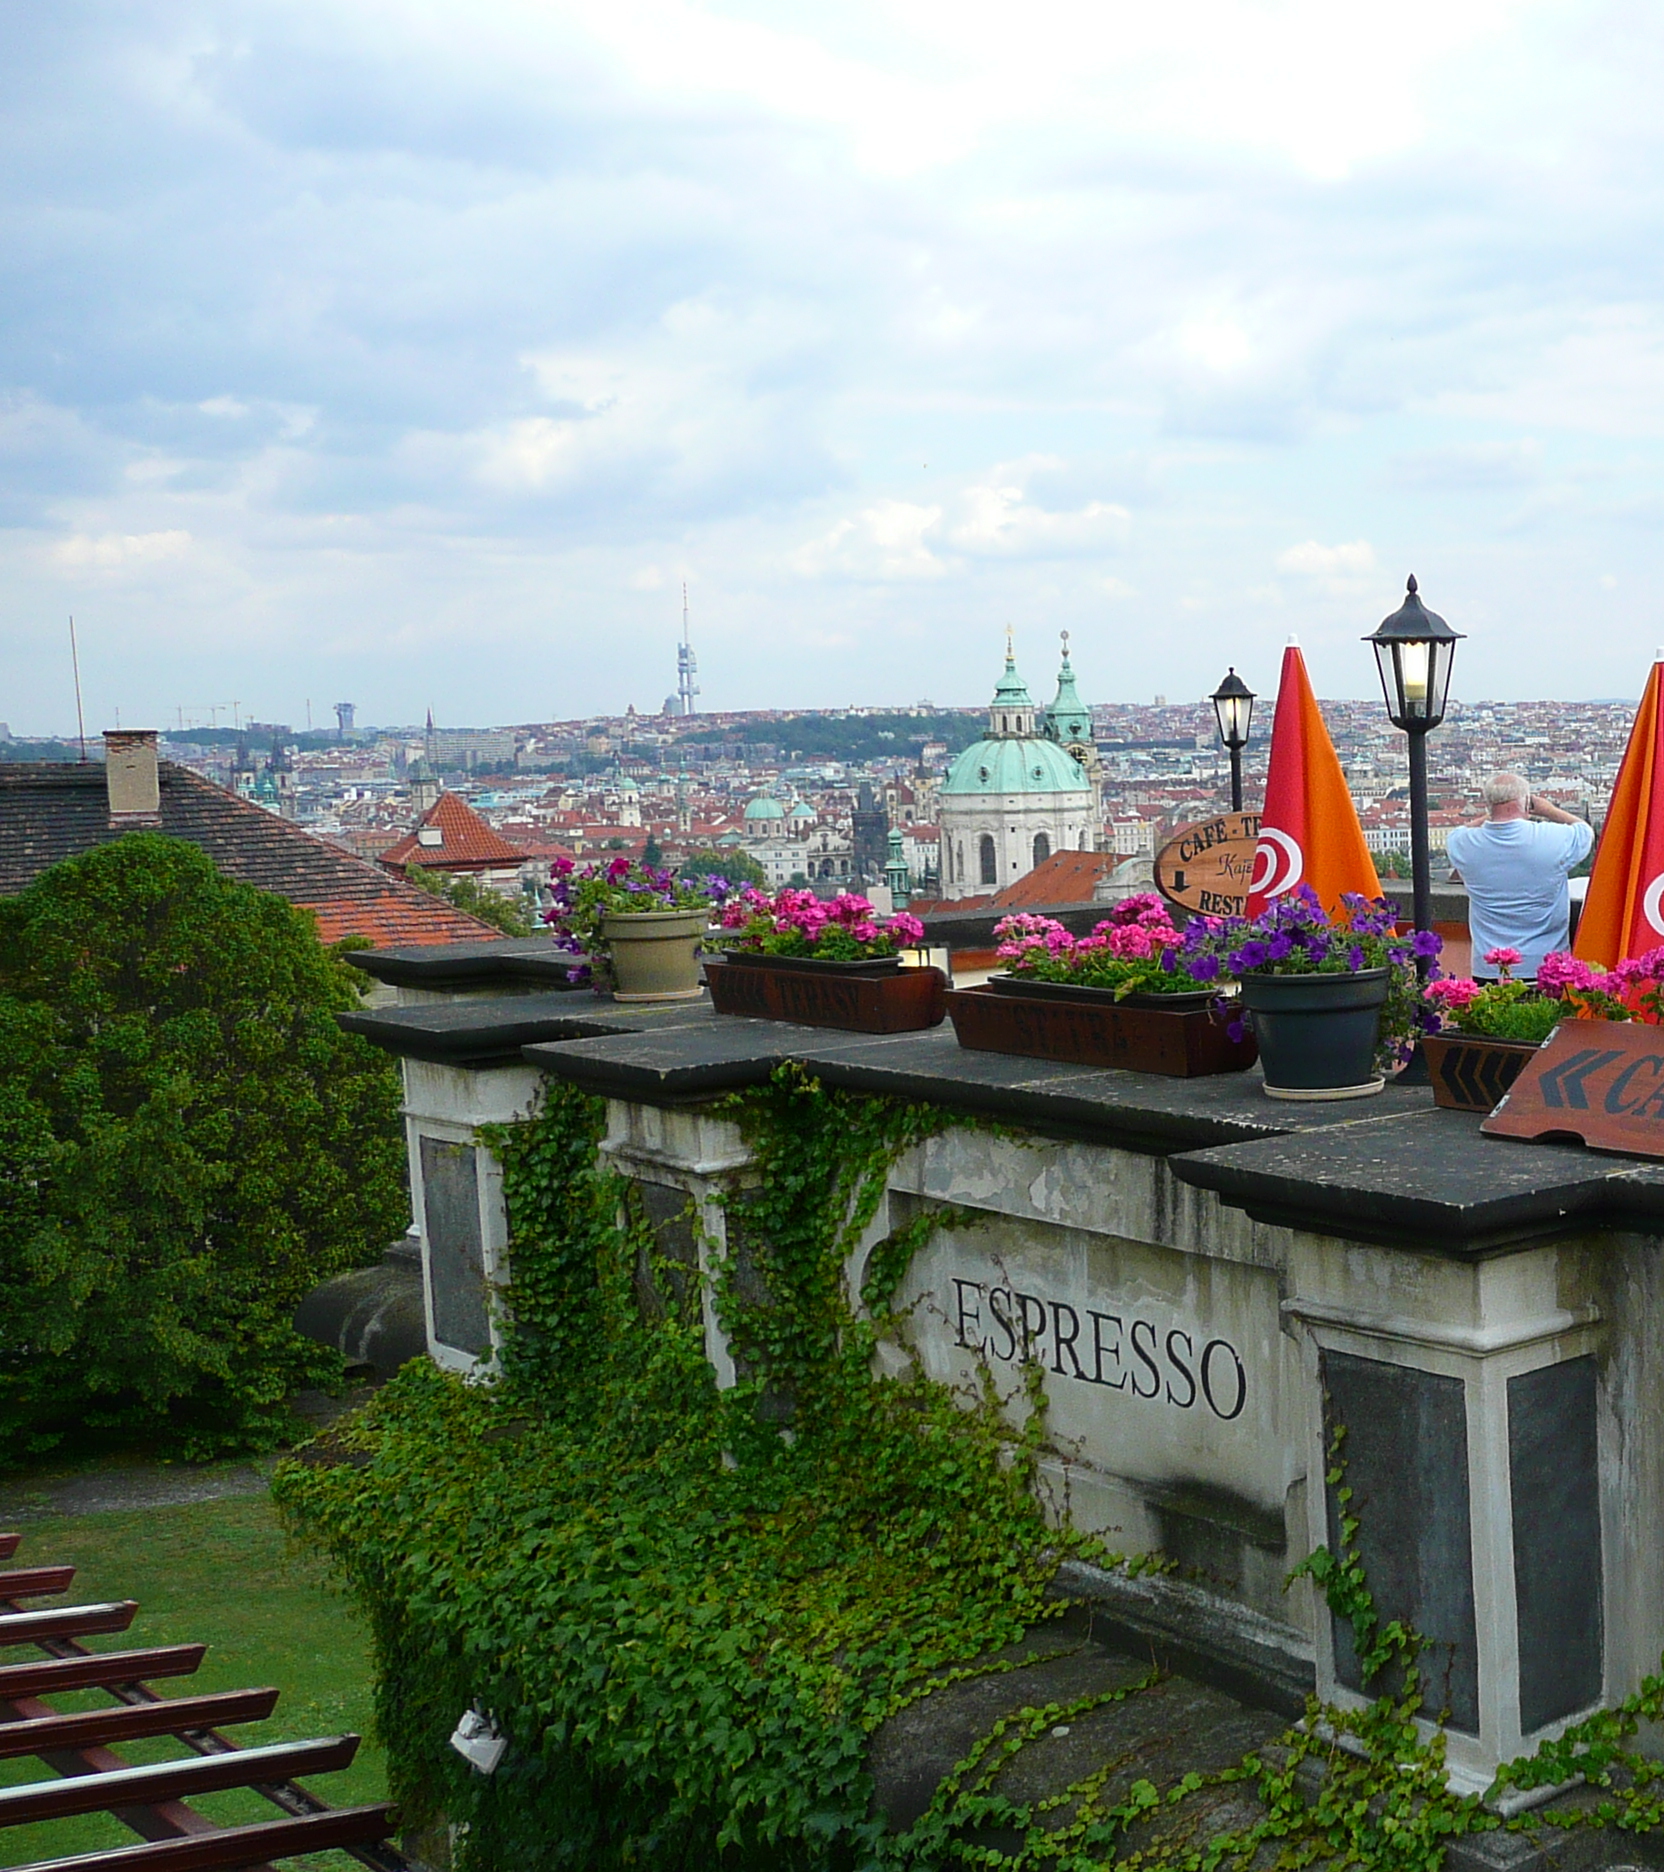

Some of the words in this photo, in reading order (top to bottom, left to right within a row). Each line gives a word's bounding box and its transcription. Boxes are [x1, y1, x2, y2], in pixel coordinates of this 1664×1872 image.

[1180, 818, 1228, 862] CAFÉ
[1200, 889, 1244, 915] REST
[951, 1277, 1247, 1421] ESPRESSO
